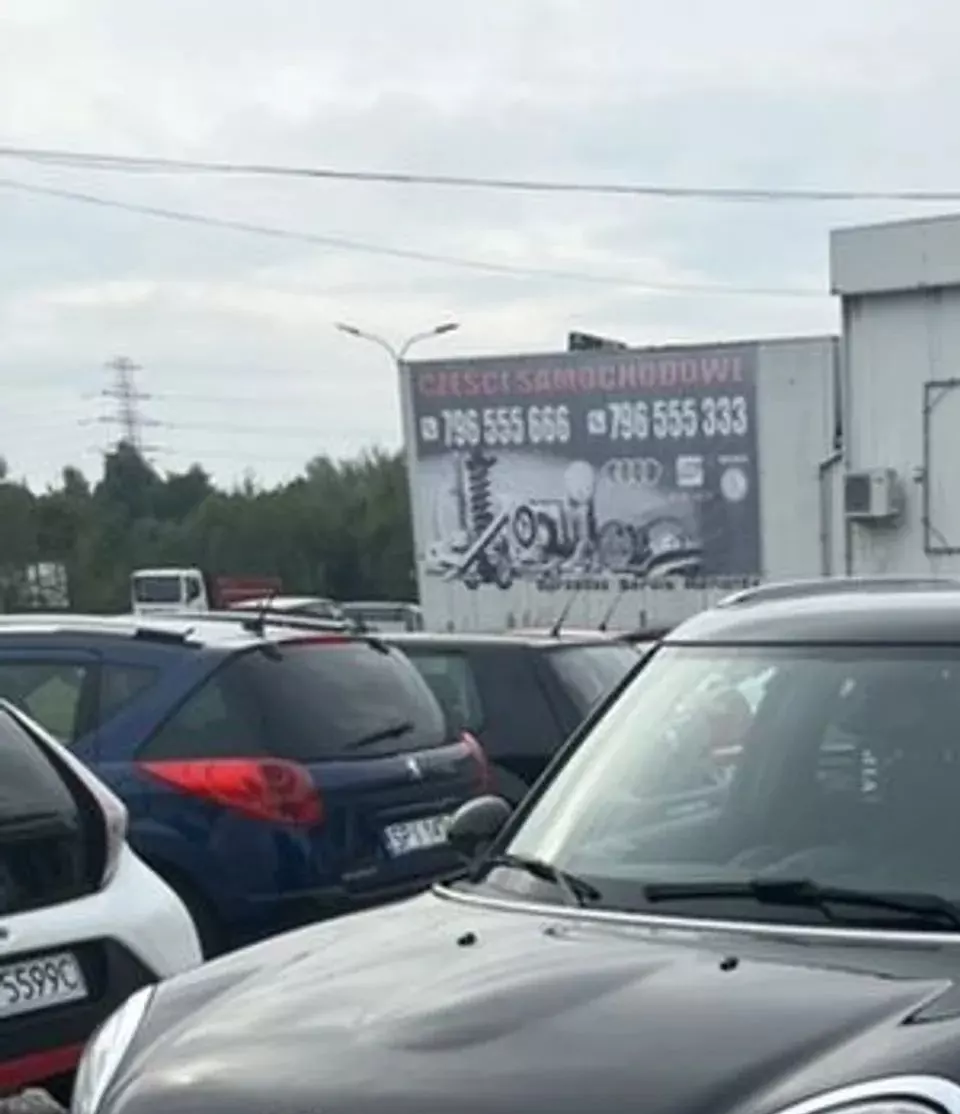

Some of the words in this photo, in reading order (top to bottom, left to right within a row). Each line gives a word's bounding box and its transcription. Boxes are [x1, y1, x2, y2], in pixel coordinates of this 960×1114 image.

[441, 408, 479, 446] 796
[483, 406, 525, 444] 555
[528, 404, 570, 442] 666
[608, 400, 649, 440] 796
[653, 398, 698, 438] 555
[702, 396, 747, 436] 333
